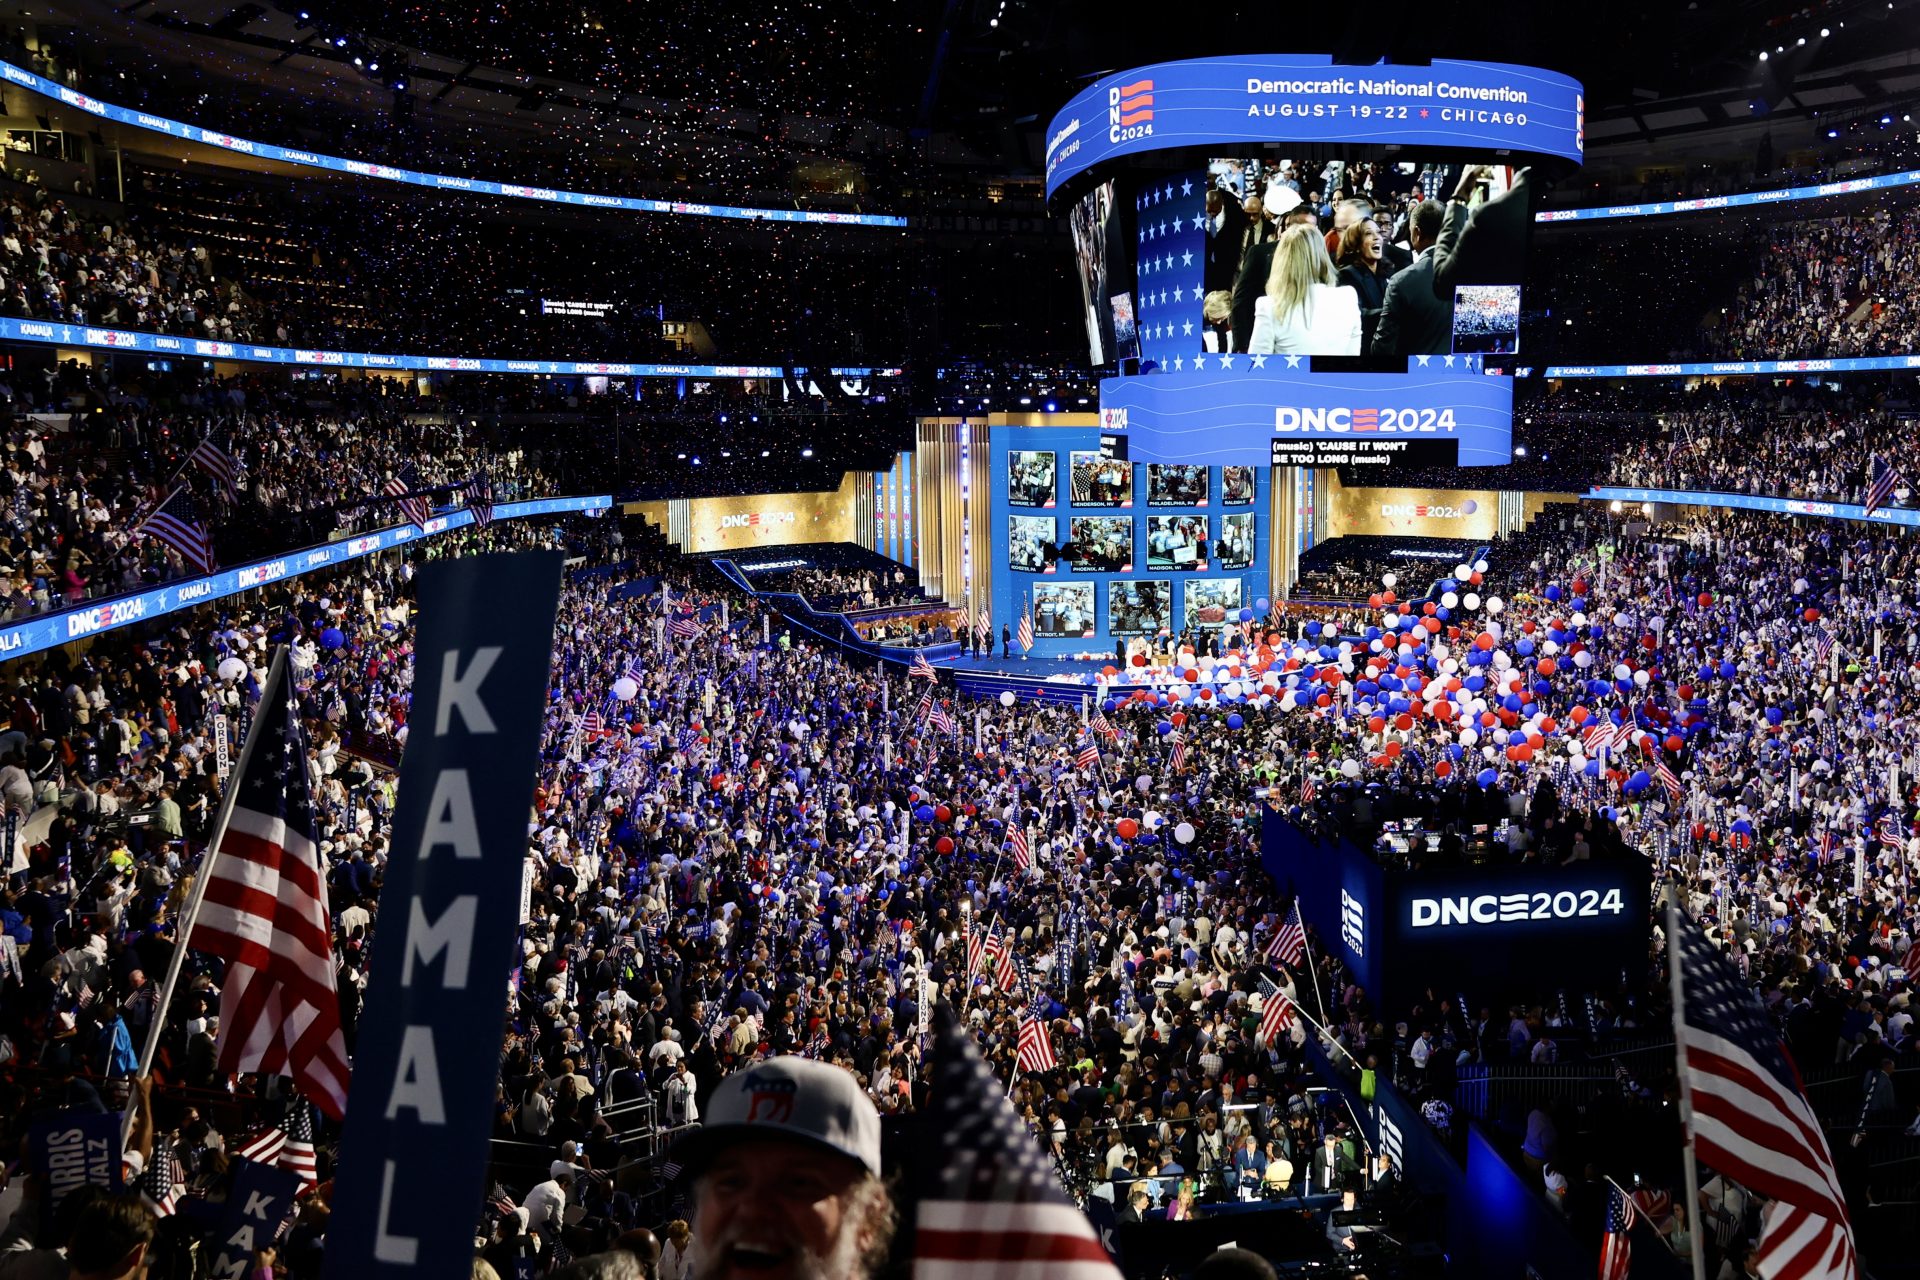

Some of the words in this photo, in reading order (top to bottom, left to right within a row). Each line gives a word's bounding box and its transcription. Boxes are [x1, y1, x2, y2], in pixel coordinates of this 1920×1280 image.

[1247, 78, 1355, 94] Democratic
[1358, 79, 1433, 97] National
[1436, 82, 1528, 103] Convention
[1247, 104, 1339, 117] AUGUST
[1350, 105, 1408, 119] 19-22
[1440, 108, 1527, 126] CHICAGO
[1121, 124, 1154, 141] 2024
[1059, 139, 1080, 162] CHICAGO
[1758, 191, 1790, 201] KAMALA
[1563, 367, 1596, 375] KAMALA
[1272, 441, 1314, 453] (music)
[1316, 441, 1358, 451] 'CAUSE
[1359, 441, 1371, 451] IT
[1372, 441, 1408, 451] WON'T
[1272, 454, 1289, 464] BE
[1290, 454, 1315, 464] TOO
[1317, 454, 1349, 464] LONG
[1351, 454, 1391, 466] (music)
[178, 582, 211, 601] KAMALA
[239, 710, 248, 746] KAMALA
[216, 721, 227, 769] OREGON
[349, 792, 357, 830] KAMALA
[587, 819, 599, 853] KAMALA
[1411, 894, 1498, 927] DNC
[1530, 888, 1624, 920] 2024
[1069, 917, 1078, 949] KAMALA
[1347, 938, 1364, 958] 2024
[375, 646, 504, 1265] KAMAL
[567, 955, 575, 997] KAMALA
[1018, 958, 1030, 990] KAMALA
[1458, 997, 1471, 1029] KAMALA
[1585, 998, 1597, 1033] KAMALA
[46, 1128, 86, 1200] ARRIS
[87, 1137, 110, 1188] ALZ
